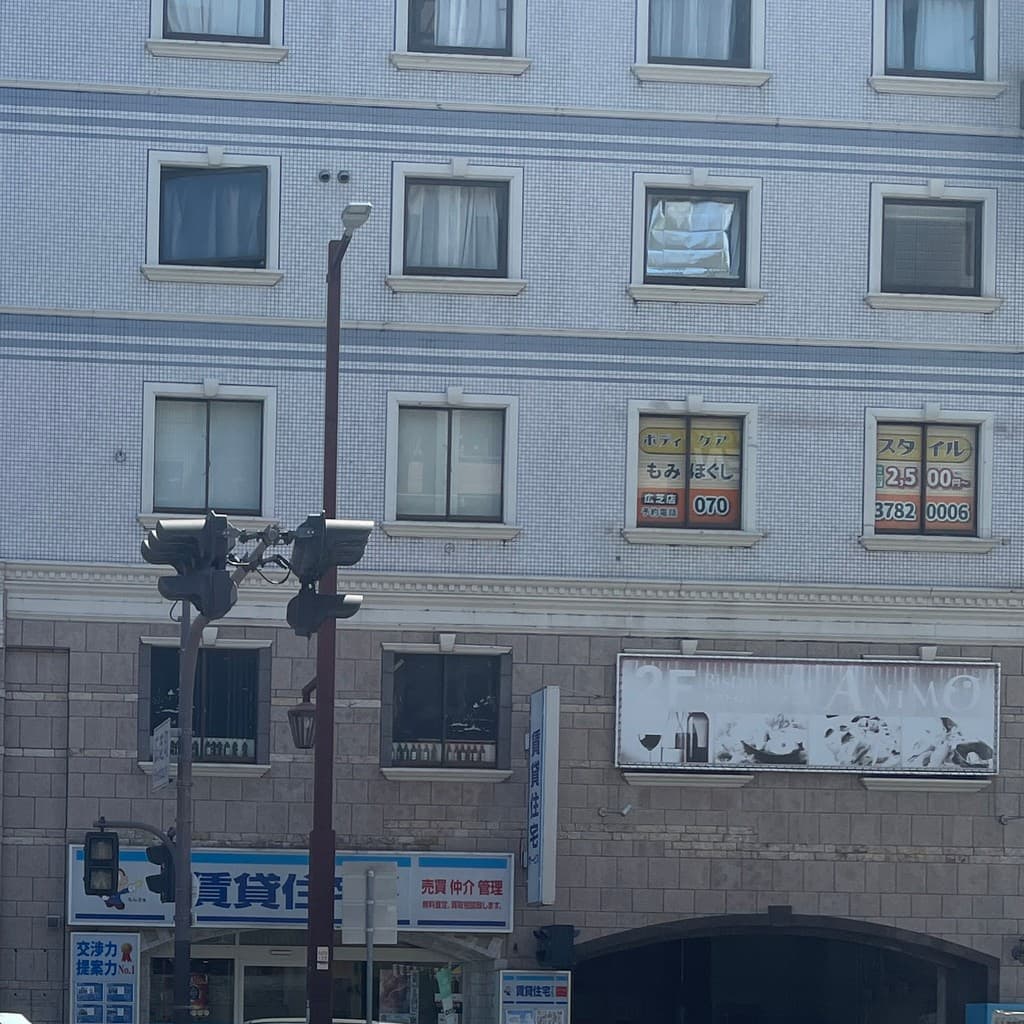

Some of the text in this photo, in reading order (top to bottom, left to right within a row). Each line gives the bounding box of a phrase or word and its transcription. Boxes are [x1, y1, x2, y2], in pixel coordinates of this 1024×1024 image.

[877, 438, 966, 457] スタイル
[646, 462, 734, 480] もみほぐし
[693, 496, 729, 515] 070
[875, 501, 970, 521] 3782 0006
[421, 879, 504, 896] 売買 仲介 管理
[76, 940, 118, 958] 交渉力
[76, 959, 136, 976] 提案力 No.1
